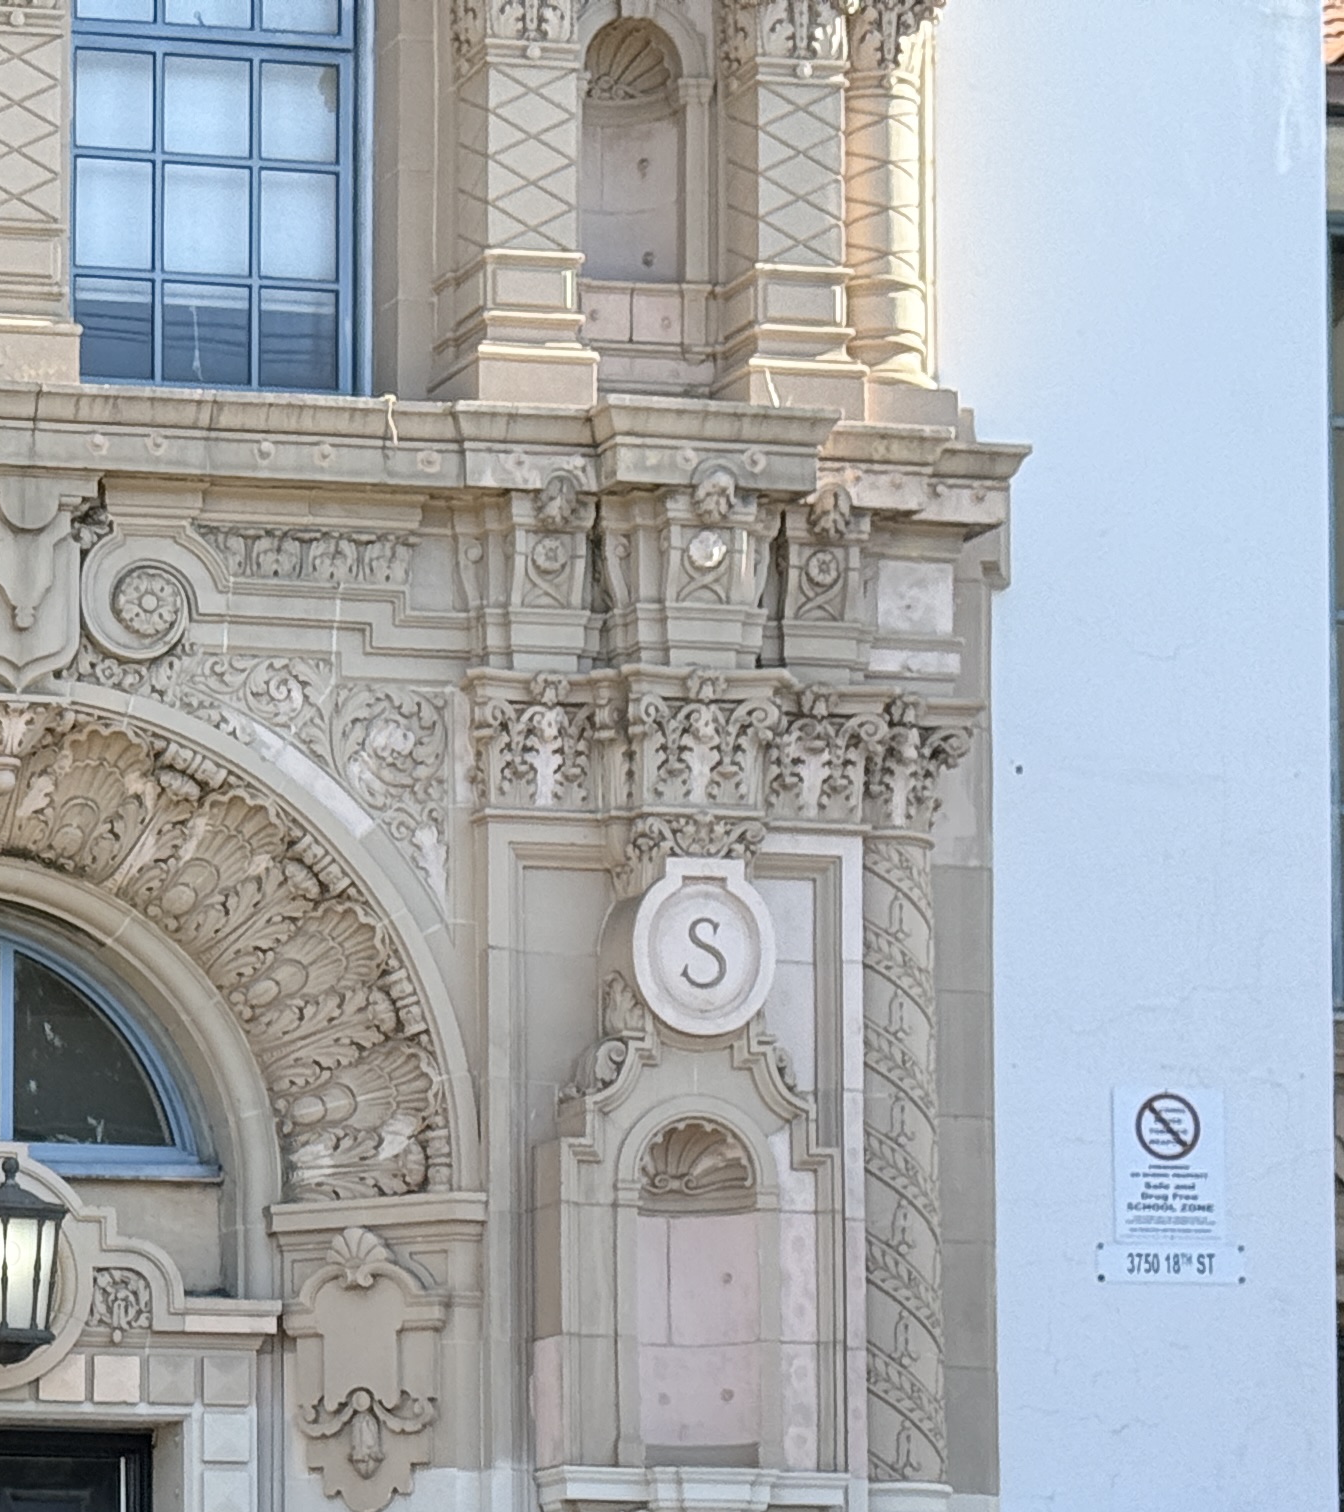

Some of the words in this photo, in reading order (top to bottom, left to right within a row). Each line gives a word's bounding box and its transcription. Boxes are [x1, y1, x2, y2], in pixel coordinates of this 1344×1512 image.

[680, 917, 727, 990] S
[1127, 1202, 1177, 1213] SCHOOL
[1180, 1203, 1214, 1213] ZONE
[1127, 1252, 1160, 1275] 3750
[1196, 1252, 1216, 1275] ST
